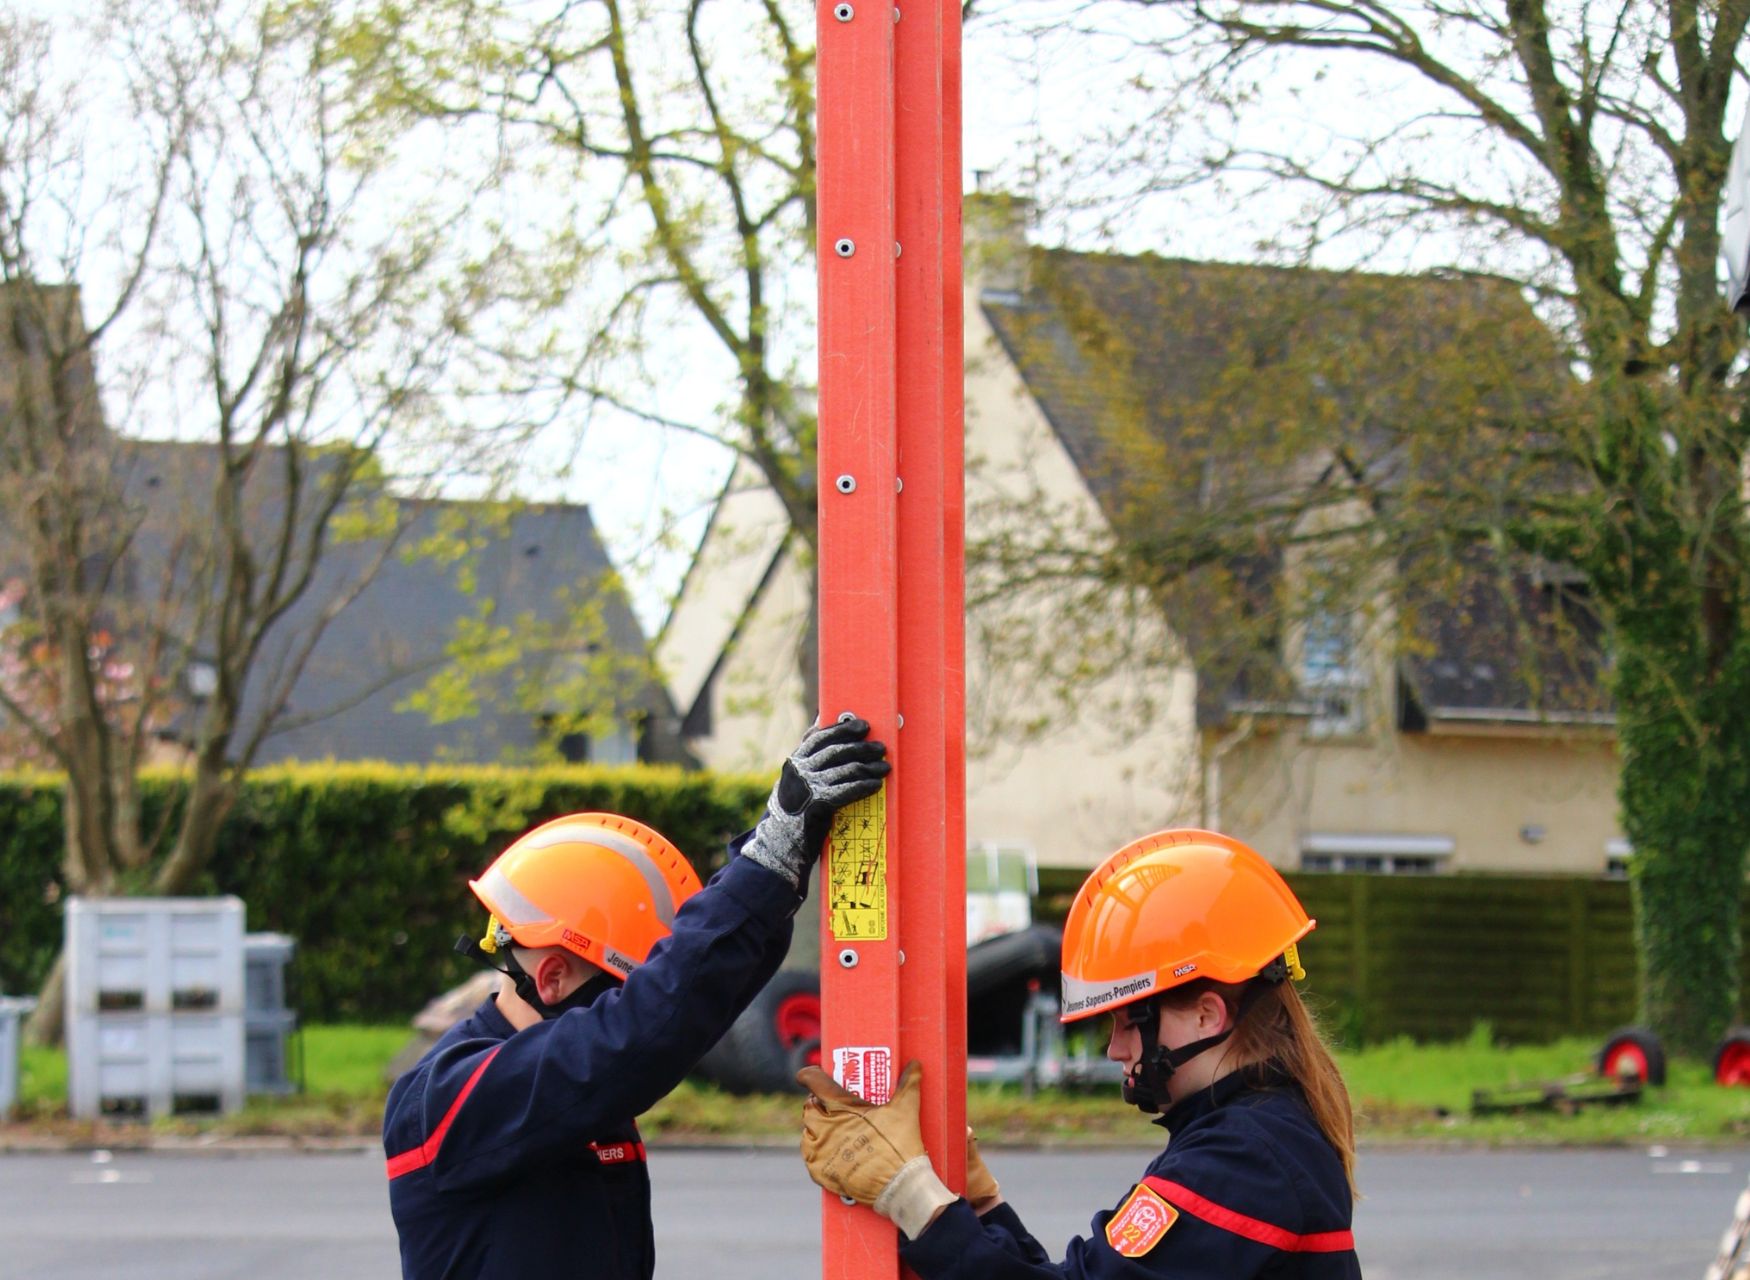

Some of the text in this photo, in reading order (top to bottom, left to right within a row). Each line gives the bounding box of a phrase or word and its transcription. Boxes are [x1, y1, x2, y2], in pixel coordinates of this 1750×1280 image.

[562, 929, 591, 949] MSA
[607, 952, 634, 974] Jeune
[1066, 1000, 1084, 1013] Jeunes
[597, 1147, 624, 1160] IERS
[1122, 1224, 1141, 1243] 22
